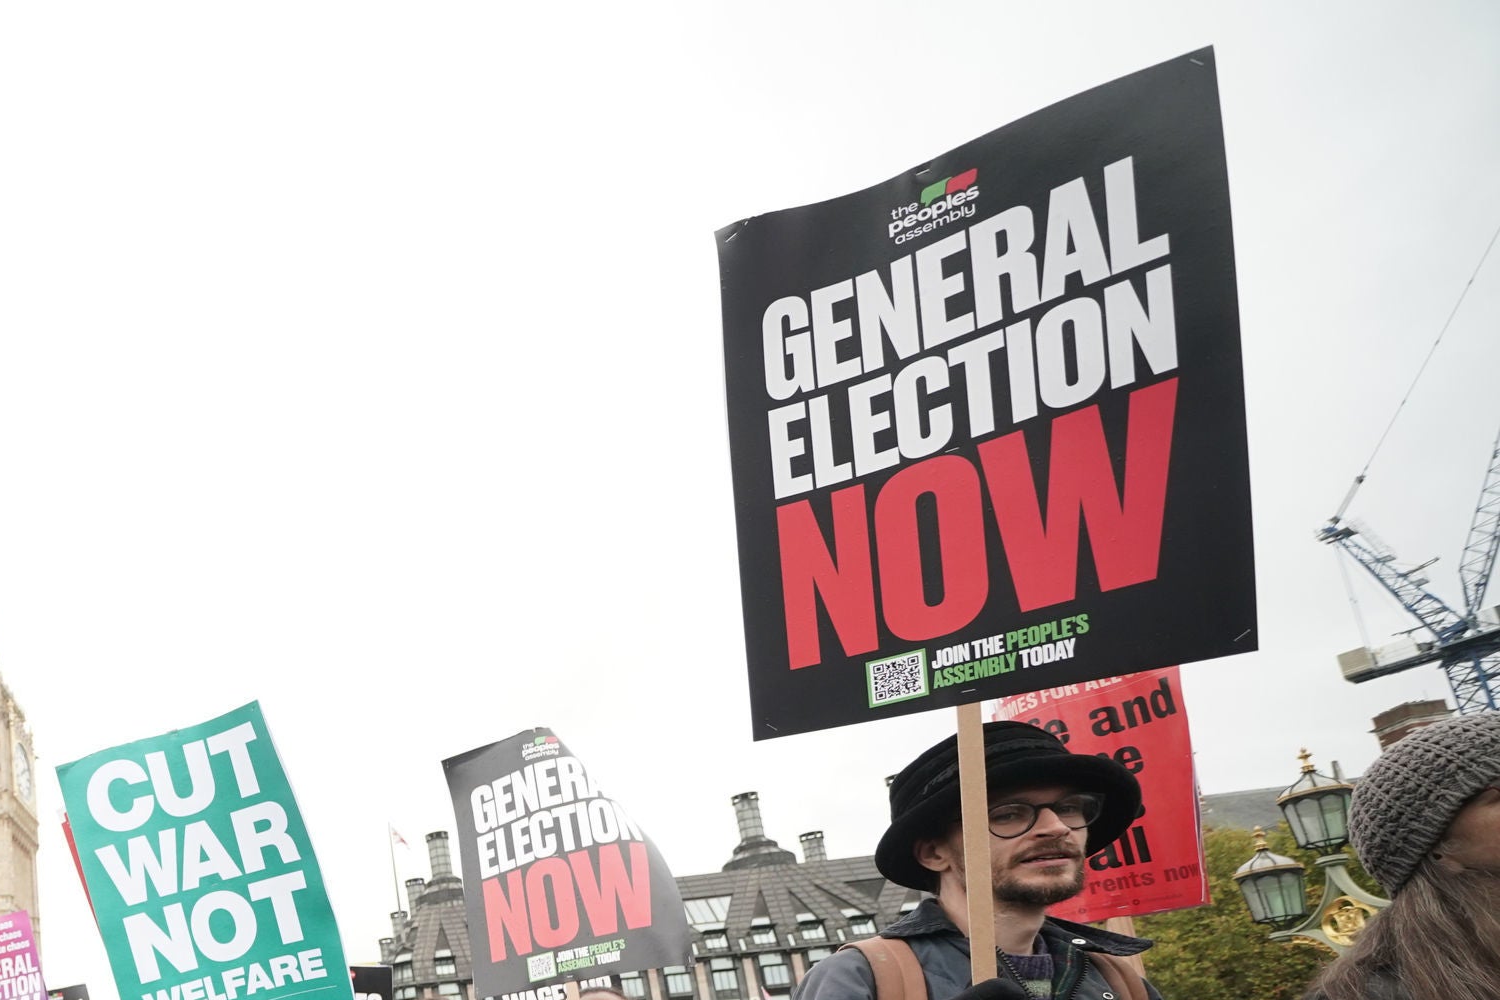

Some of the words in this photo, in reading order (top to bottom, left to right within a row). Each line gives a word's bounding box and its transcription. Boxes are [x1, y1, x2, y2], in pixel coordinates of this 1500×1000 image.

[888, 185, 980, 238] peoples
[891, 203, 918, 219] the
[894, 204, 976, 245] assembly
[762, 155, 1170, 401] GENERAL
[767, 263, 1179, 500] ELECTION
[775, 376, 1180, 671] NOW
[931, 642, 971, 669] JOIN
[971, 634, 1005, 659] THE
[1005, 613, 1090, 651] PEOPLE'S
[933, 652, 1018, 690] ASSEMBLY
[1018, 637, 1076, 669] TODAY
[1040, 682, 1080, 704] FOR
[1089, 677, 1177, 737] and
[87, 721, 260, 832] CUT
[470, 756, 604, 834] GENER
[94, 801, 302, 907] WAR
[477, 798, 643, 880] ELECTION
[1089, 826, 1152, 871] all
[1163, 863, 1199, 883] now
[122, 869, 307, 985] NOT
[482, 842, 652, 964] NOW
[0, 929, 22, 942] chaos
[7, 939, 30, 952] chaos
[556, 949, 574, 962] JOIN
[574, 946, 589, 958] THE
[595, 950, 621, 965] TODAY
